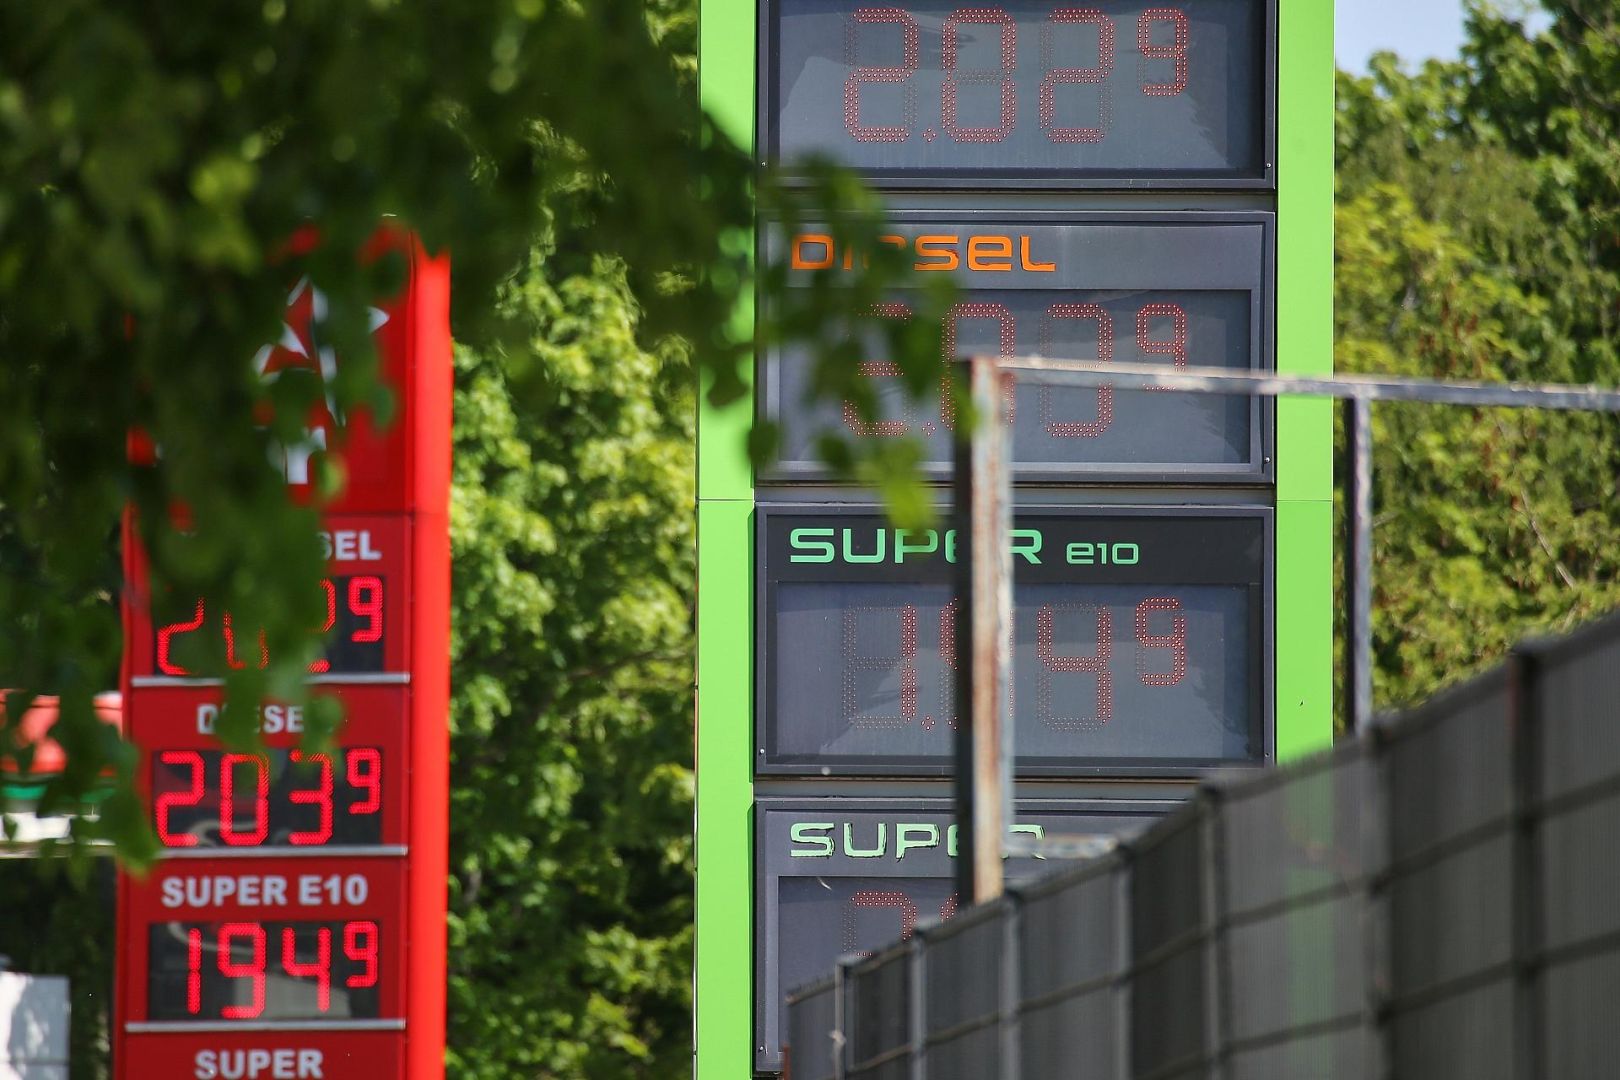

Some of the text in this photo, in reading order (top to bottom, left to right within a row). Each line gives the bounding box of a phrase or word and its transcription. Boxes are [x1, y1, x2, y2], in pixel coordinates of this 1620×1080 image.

[789, 528, 1043, 564] SUPR
[197, 703, 334, 734] DSE
[790, 822, 1047, 861] SUP
[161, 873, 369, 908] SUPER E10
[194, 1048, 324, 1079] SUPER
